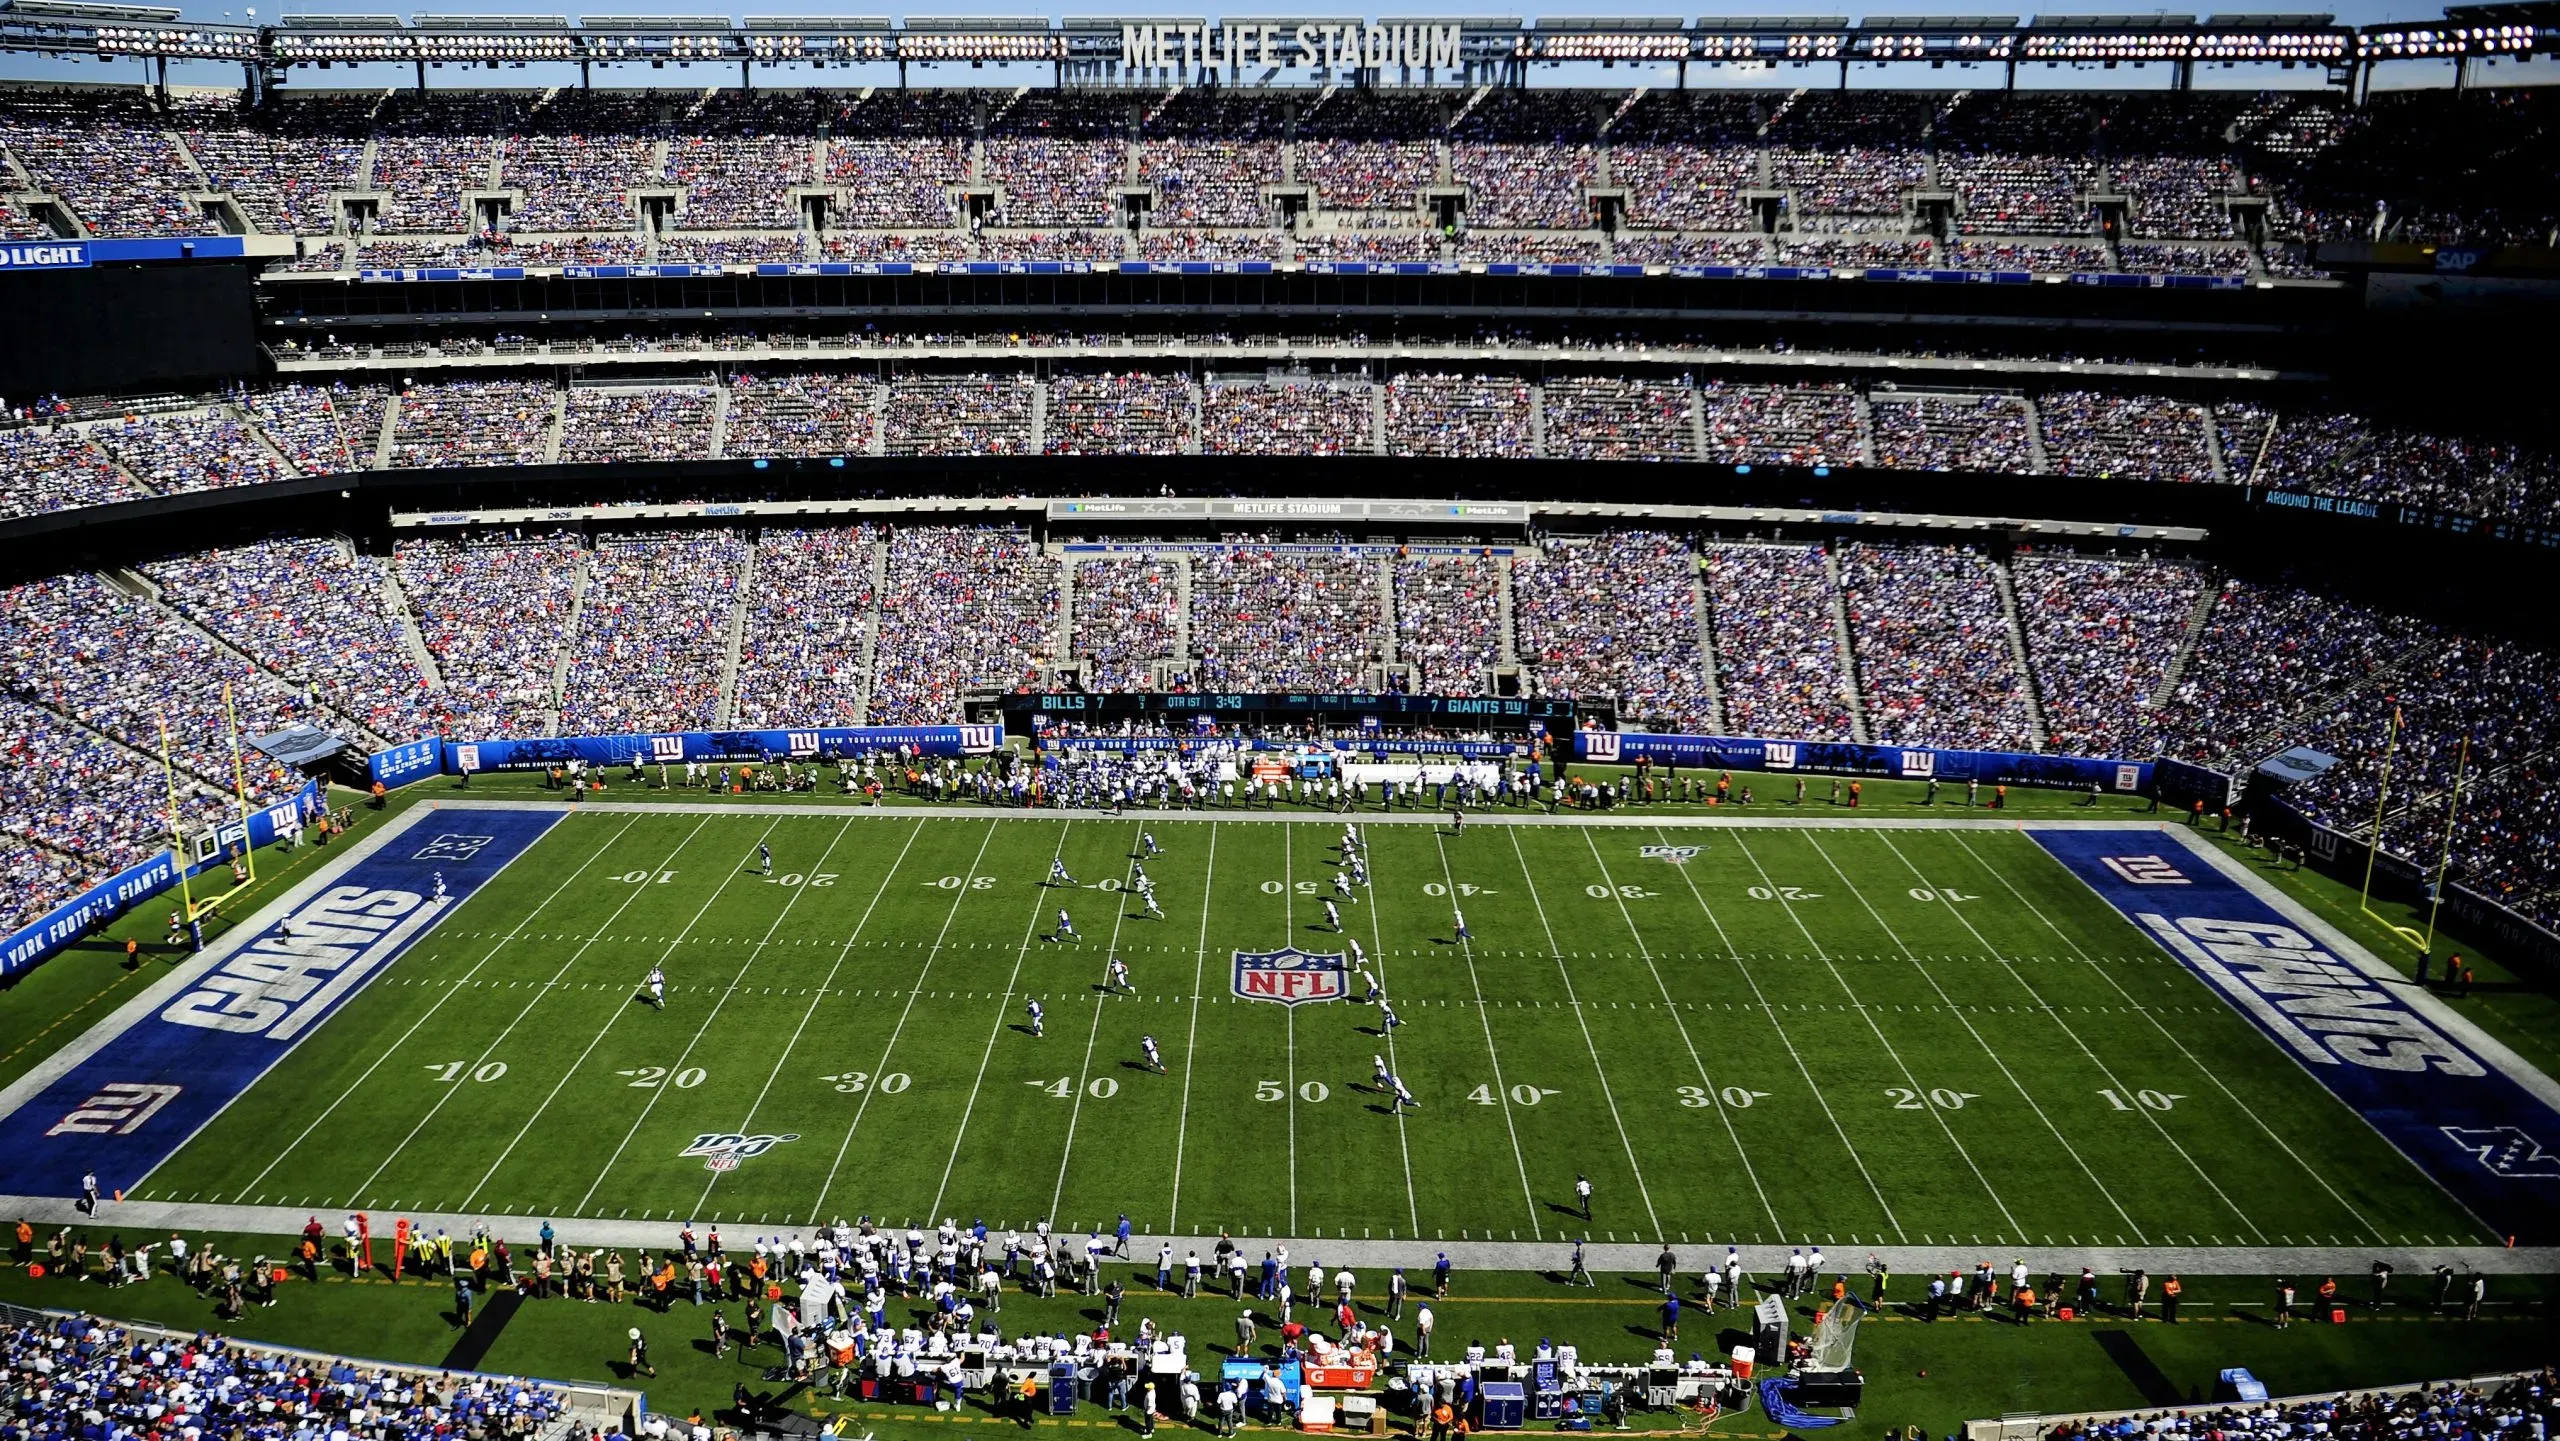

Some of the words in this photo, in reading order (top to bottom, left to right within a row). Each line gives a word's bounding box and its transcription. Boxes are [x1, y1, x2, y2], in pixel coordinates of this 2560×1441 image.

[1122, 24, 1280, 67] METLIFE
[1295, 24, 1461, 68] STADIUM
[11, 246, 84, 265] LIGHT
[2435, 252, 2476, 269] SAP
[1085, 504, 1126, 512] MetLife
[1233, 503, 1284, 513] METLIFE
[1287, 503, 1341, 513] STADIUM
[2266, 490, 2309, 508] AROUND
[2313, 496, 2334, 511] THE
[2336, 500, 2380, 517] LEAGUE
[705, 506, 740, 516] MetLife
[1466, 507, 1508, 515] MetLife
[432, 515, 446, 523] BUD
[447, 514, 468, 522] LIGHT
[1042, 696, 1085, 709] BILLS
[1097, 696, 1104, 709] 7
[1168, 697, 1185, 707] QTR
[1216, 696, 1242, 709] 3:43
[1431, 700, 1439, 712] 7
[1448, 700, 1500, 713] GIANTS
[1505, 701, 1522, 714] ny
[788, 733, 820, 756] ny
[876, 735, 920, 743] FOOTBALL
[960, 727, 994, 754] ny
[1075, 741, 1096, 749] NEW
[1102, 741, 1127, 749] YORK
[651, 736, 684, 761] ny
[1377, 743, 1402, 751] YORK
[1407, 744, 1458, 752] FOOTBALL
[1463, 745, 1501, 753] GIANTS
[1585, 734, 1621, 761] ny
[1677, 745, 1722, 753] FOOTBALL
[1727, 747, 1762, 755] GIANTS
[1764, 743, 1796, 769] ny
[379, 764, 400, 775] WORLD
[401, 753, 434, 769] CHAMPIONS
[1901, 751, 1935, 777] ny
[269, 802, 298, 837] ny
[2310, 828, 2339, 862] ny
[2101, 855, 2192, 884] ny
[622, 870, 680, 884] 10
[778, 873, 839, 887] 20
[937, 876, 996, 889] 30
[1262, 881, 1318, 895] 50
[1423, 883, 1483, 897] 40
[1586, 884, 1648, 898] 30
[1748, 887, 1809, 900] 20
[1909, 888, 1966, 902] 10
[7, 932, 46, 967] YORK
[118, 864, 168, 901] GIANTS
[2452, 897, 2485, 925] NEW
[161, 886, 423, 1034] GIANTS
[1247, 971, 1335, 997] NFL
[2176, 917, 2487, 1077] GIANTS
[431, 1061, 508, 1083] 10
[627, 1066, 708, 1088] 20
[834, 1071, 912, 1094] 30
[1043, 1076, 1119, 1099] 40
[1255, 1081, 1330, 1103] 50
[1467, 1083, 1543, 1106] 40
[1676, 1086, 1754, 1109] 30
[1885, 1087, 1965, 1110] 20
[2098, 1088, 2173, 1111] 10
[45, 1082, 184, 1135] ny
[708, 1159, 735, 1169] NFL
[878, 1334, 889, 1343] 73
[904, 1335, 915, 1344] 67
[955, 1339, 967, 1348] 76
[980, 1340, 991, 1349] 70
[1077, 1338, 1087, 1346] 19
[1173, 1341, 1180, 1349] 5
[1037, 1342, 1048, 1350] 26
[1469, 1352, 1481, 1361] 22
[1500, 1351, 1511, 1360] 42
[948, 1367, 960, 1378] 61
[1310, 1369, 1325, 1383] G
